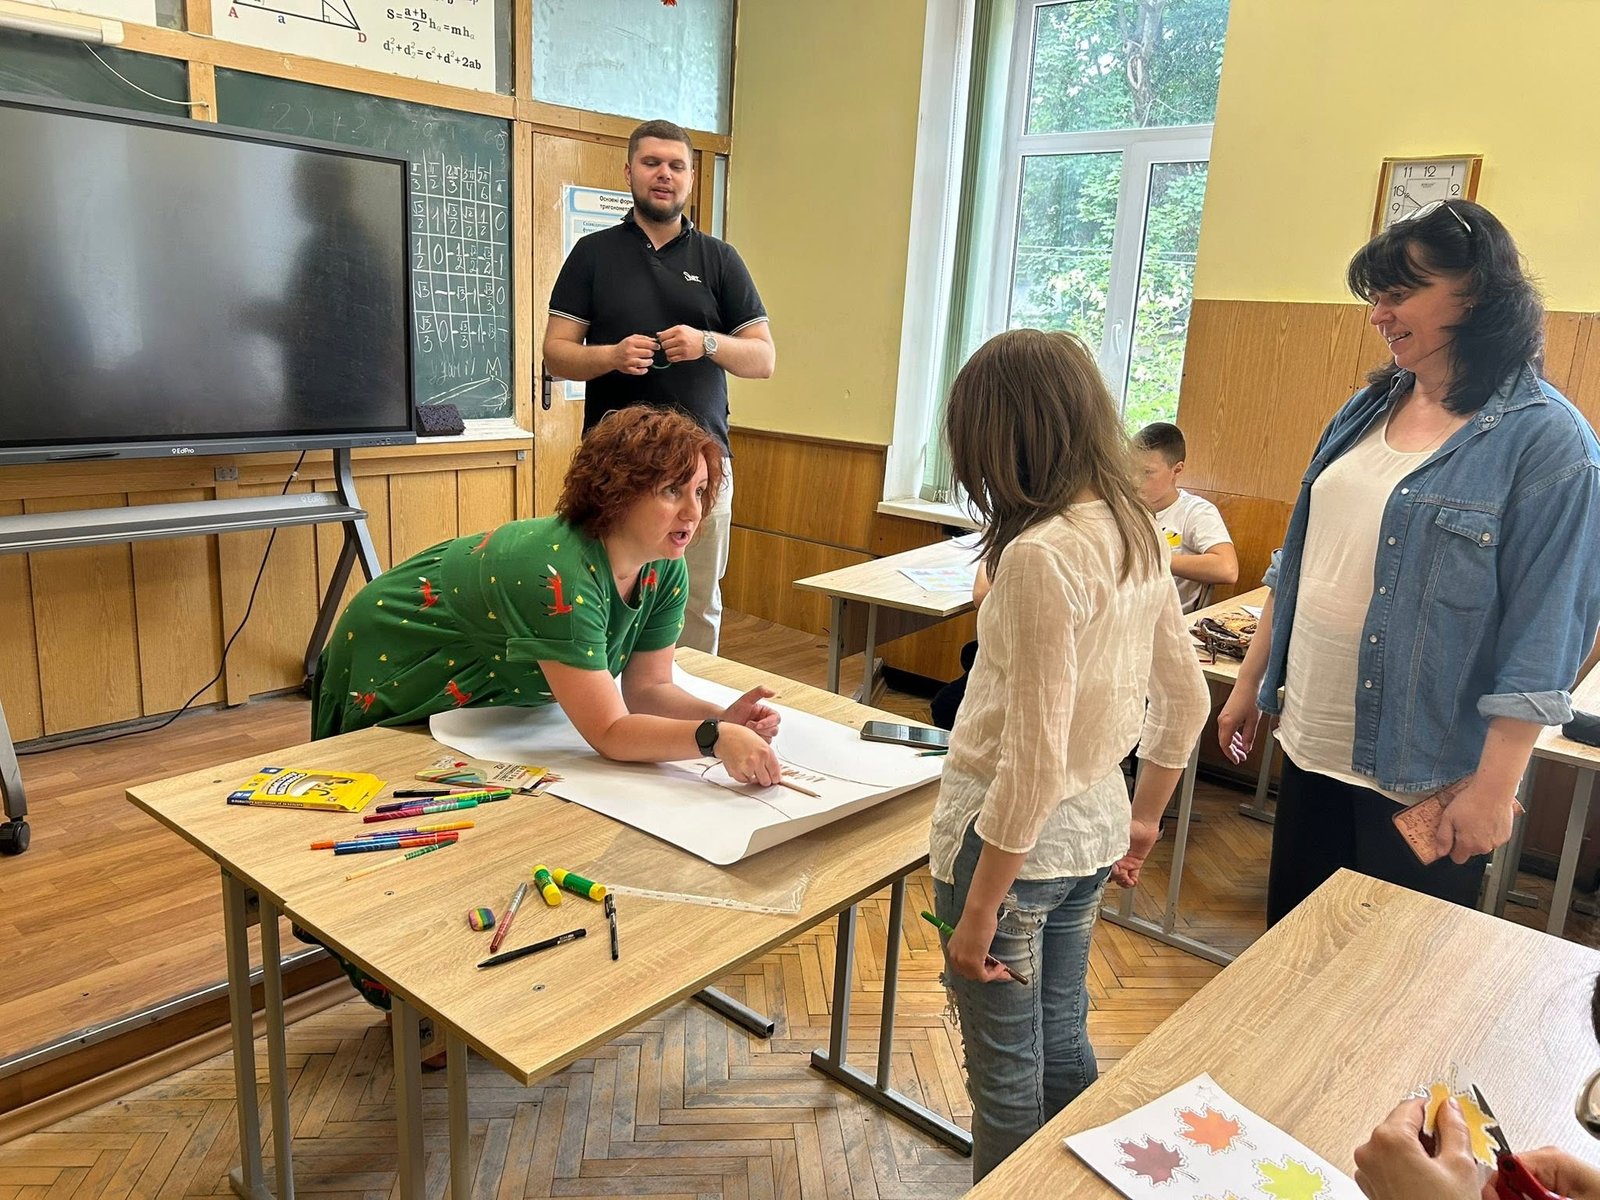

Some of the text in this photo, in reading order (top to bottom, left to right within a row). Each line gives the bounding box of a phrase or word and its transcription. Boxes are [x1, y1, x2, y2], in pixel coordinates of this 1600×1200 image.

[228, 7, 239, 19] A
[277, 15, 286, 24] a
[357, 32, 367, 43] D
[1403, 165, 1455, 178] 11 12 1
[1393, 185, 1406, 197] 10
[1450, 184, 1460, 196] 2
[1391, 203, 1401, 215] 9
